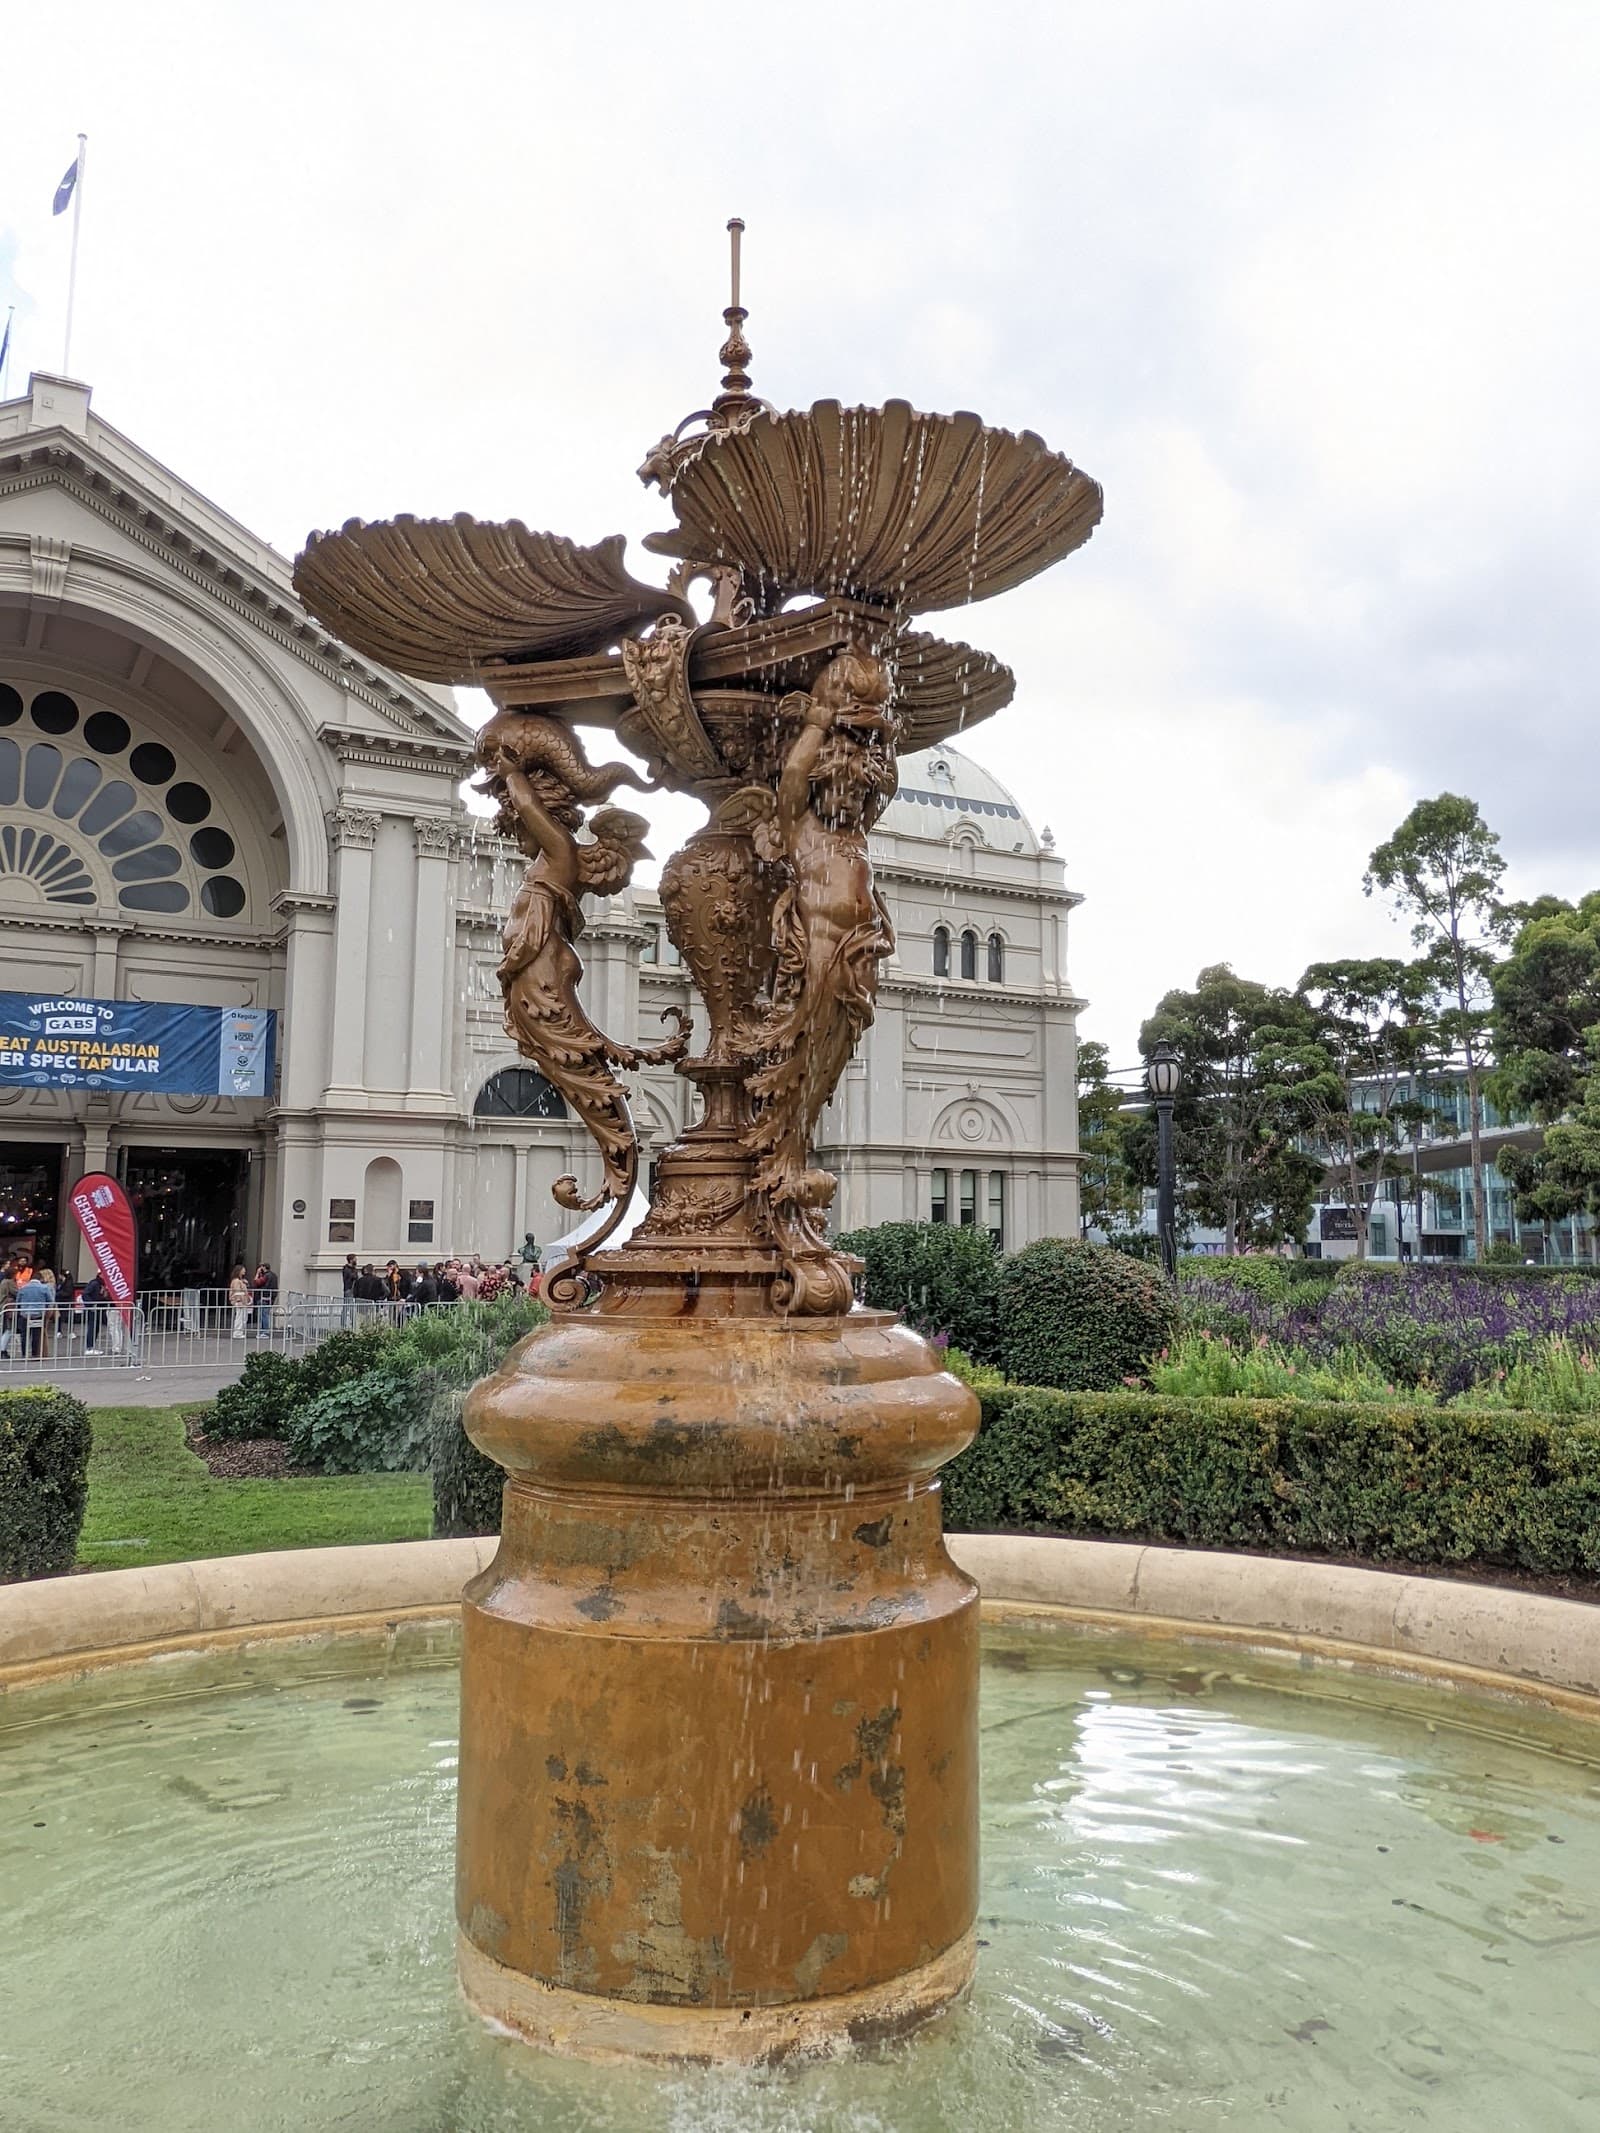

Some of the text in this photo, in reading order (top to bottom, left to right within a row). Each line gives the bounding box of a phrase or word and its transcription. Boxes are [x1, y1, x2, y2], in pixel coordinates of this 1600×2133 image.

[28, 1001, 114, 1020] WELCOME TO
[49, 1019, 94, 1029] GABS
[0, 1036, 159, 1058] EAT AUSTRALASIAN
[0, 1052, 159, 1073] ER SPECTAPULAR
[74, 1195, 104, 1242] GENERAL
[94, 1241, 131, 1300] ADMISSION
